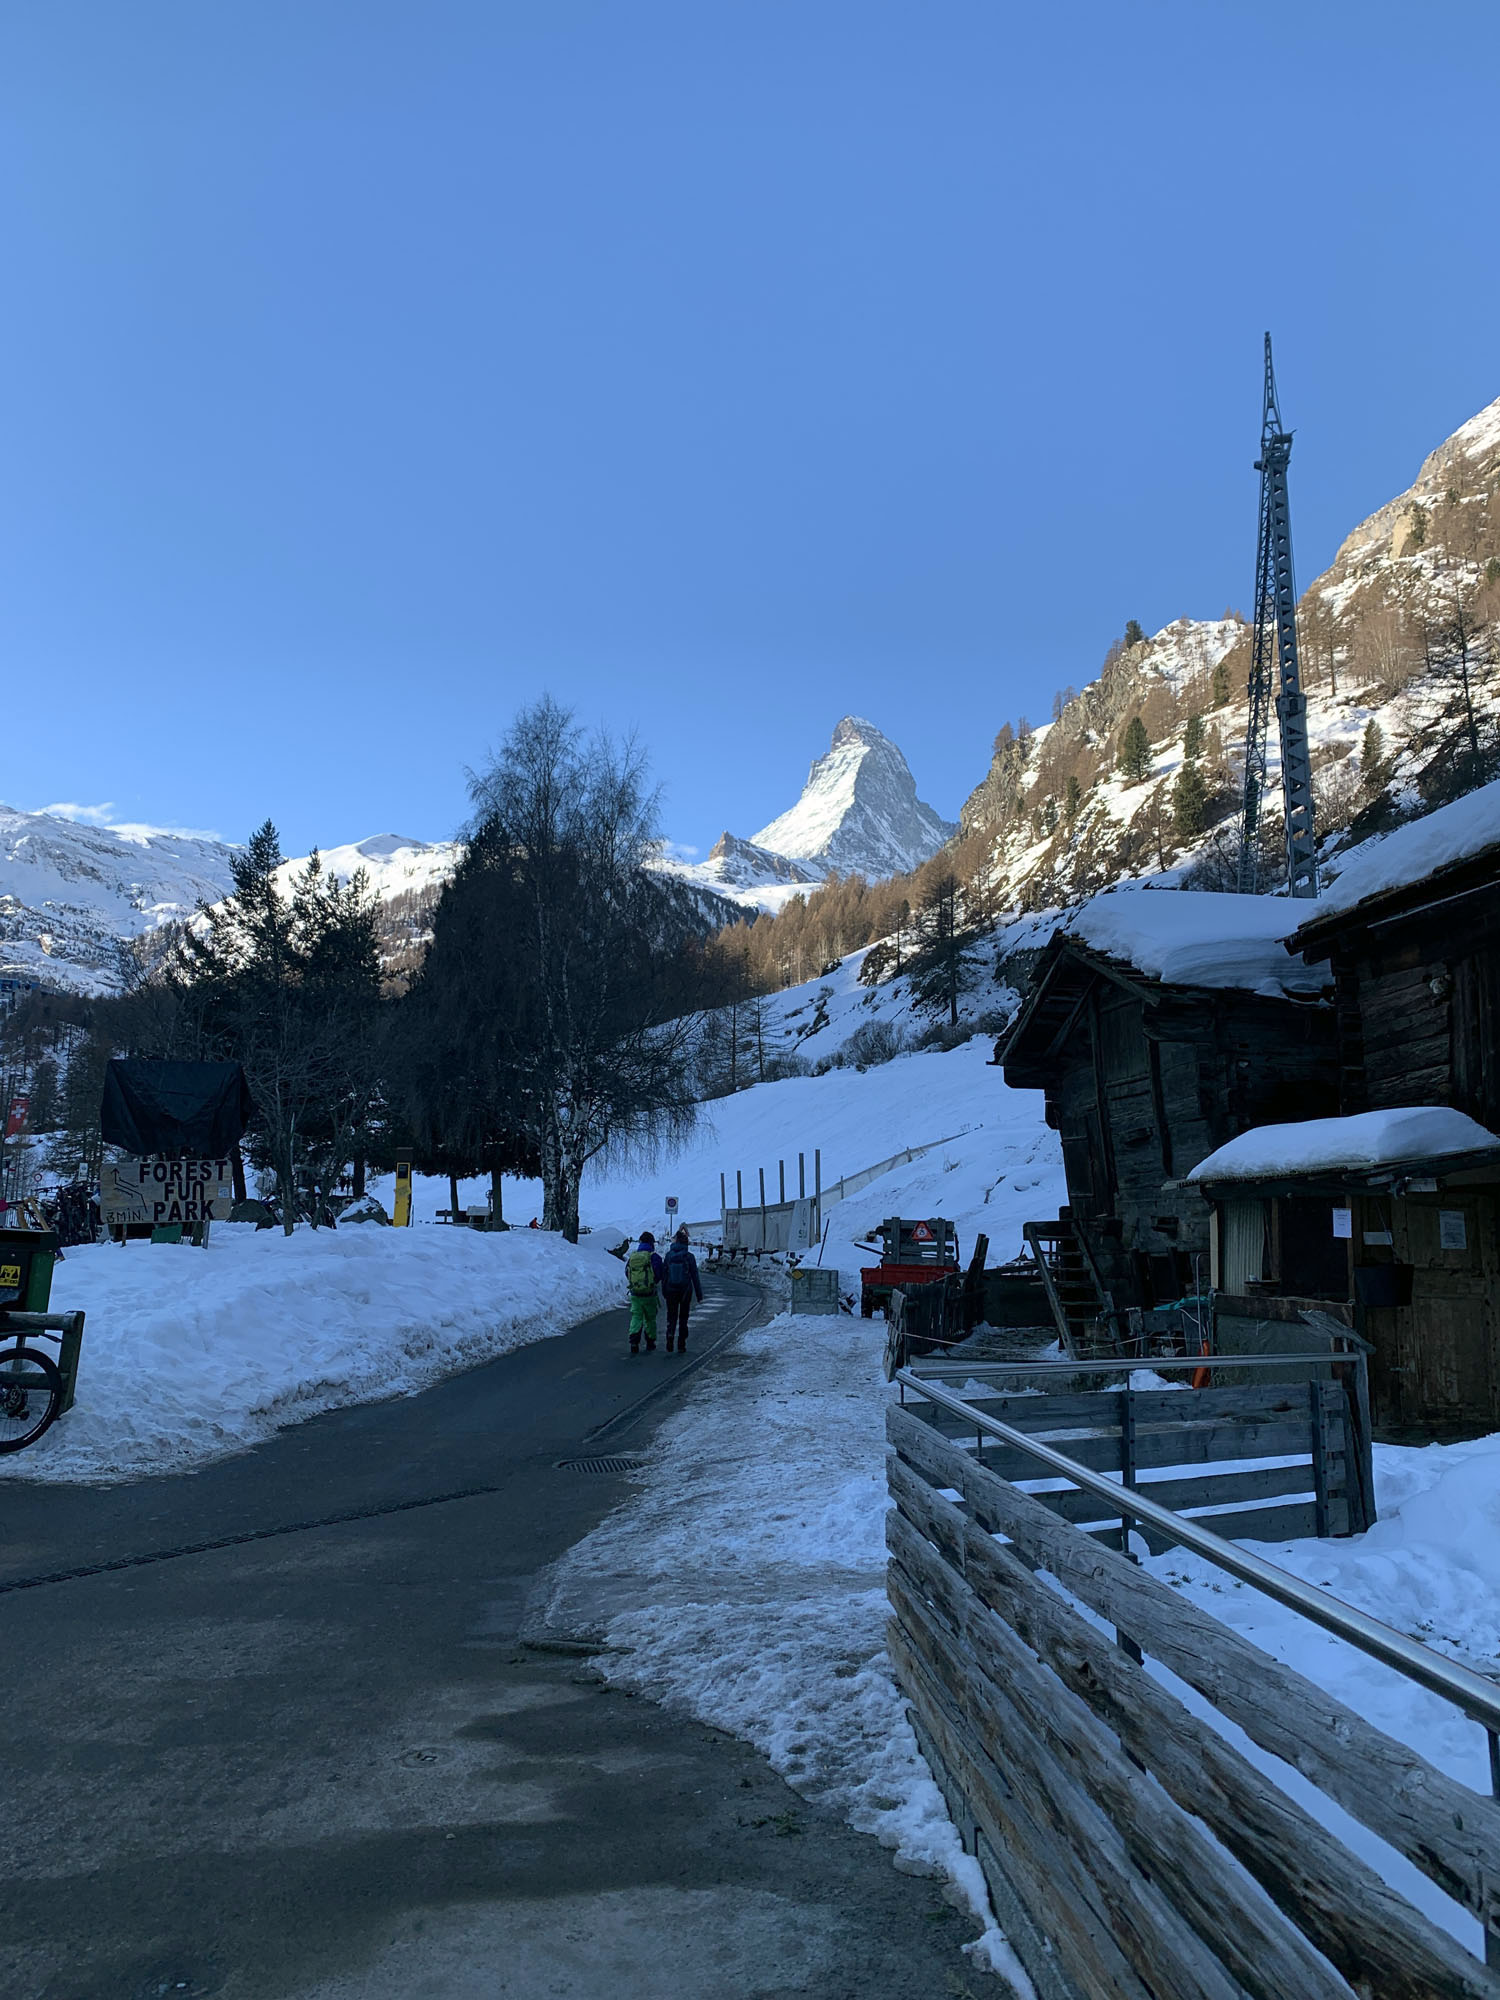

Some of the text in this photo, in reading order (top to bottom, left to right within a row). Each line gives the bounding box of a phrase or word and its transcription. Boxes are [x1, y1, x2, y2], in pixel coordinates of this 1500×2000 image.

[139, 1161, 228, 1184] FOREST
[106, 1210, 115, 1223] 3
[153, 1199, 215, 1222] PARK
